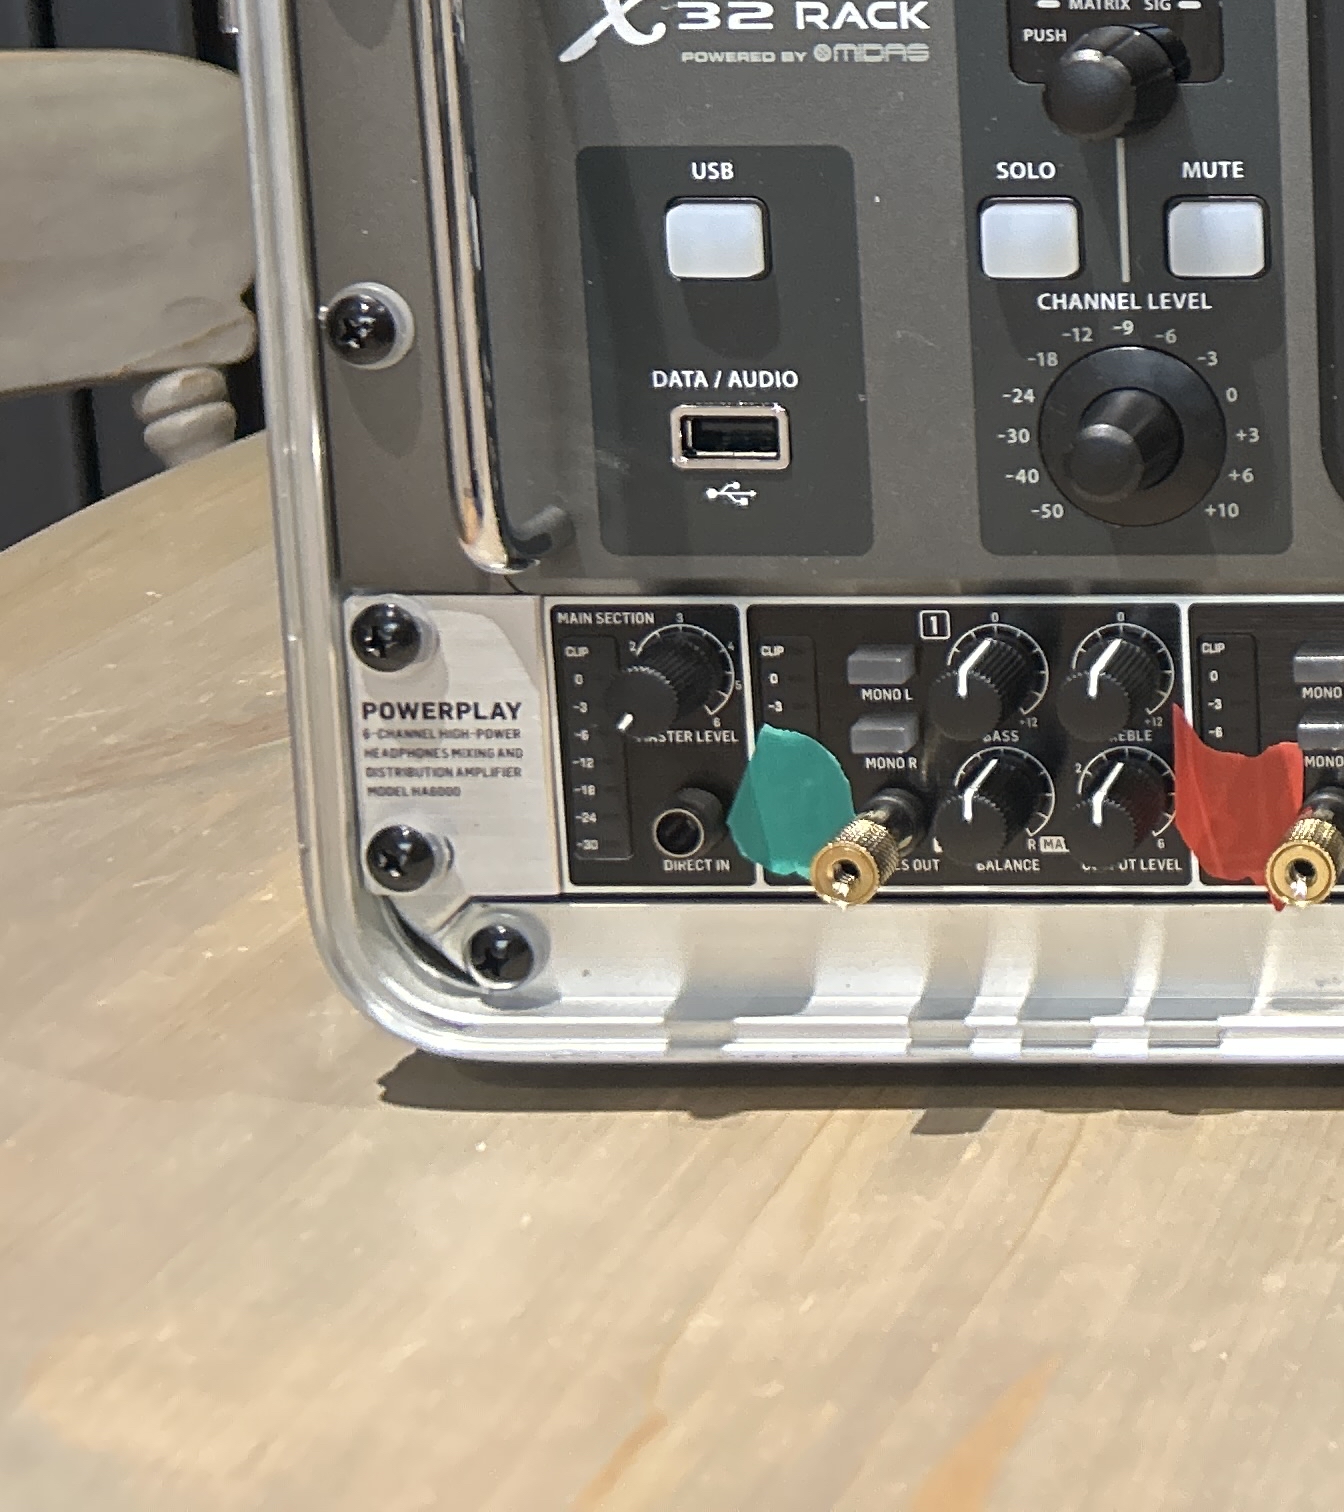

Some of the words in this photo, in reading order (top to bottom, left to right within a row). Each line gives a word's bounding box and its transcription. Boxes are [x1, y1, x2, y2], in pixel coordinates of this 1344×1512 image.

[795, 1, 930, 29] RACK
[1023, 29, 1066, 42] PUSH
[682, 52, 775, 62] POWERED
[781, 52, 807, 62] BY
[692, 162, 733, 179] USB
[997, 162, 1055, 179] SOLO
[1183, 161, 1244, 178] MUTE
[1038, 293, 1142, 310] CHANNEL
[1148, 293, 1212, 309] LEVEL
[1062, 327, 1093, 342] -12
[1113, 320, 1134, 335] -9
[1156, 329, 1176, 343] -6
[1028, 352, 1058, 366] -18
[1198, 351, 1218, 366] -3
[653, 370, 708, 388] DATA
[728, 371, 798, 388] AUDIO
[1003, 389, 1035, 403] -24
[1226, 388, 1237, 402] 0
[998, 429, 1030, 443] -30
[1236, 428, 1259, 442] +3
[1006, 469, 1039, 483] -40
[1229, 468, 1254, 482] +6
[1031, 504, 1063, 518] -50
[1205, 503, 1239, 517] +10
[558, 613, 592, 624] MAIN
[596, 612, 654, 624] SECTION
[929, 616, 939, 634] 1
[565, 646, 589, 657] CLIP
[862, 689, 901, 700] MONO
[905, 689, 912, 700] L
[1302, 687, 1342, 699] MONO
[362, 702, 522, 720] POWERPLAY
[696, 730, 738, 742] LEVEL
[497, 748, 523, 758] AND
[866, 757, 905, 769] MONO
[909, 757, 917, 768] R
[1305, 756, 1344, 767] MONO
[664, 859, 712, 871] DIRECT
[716, 860, 730, 871] IN
[1140, 859, 1182, 870] LEVEL
